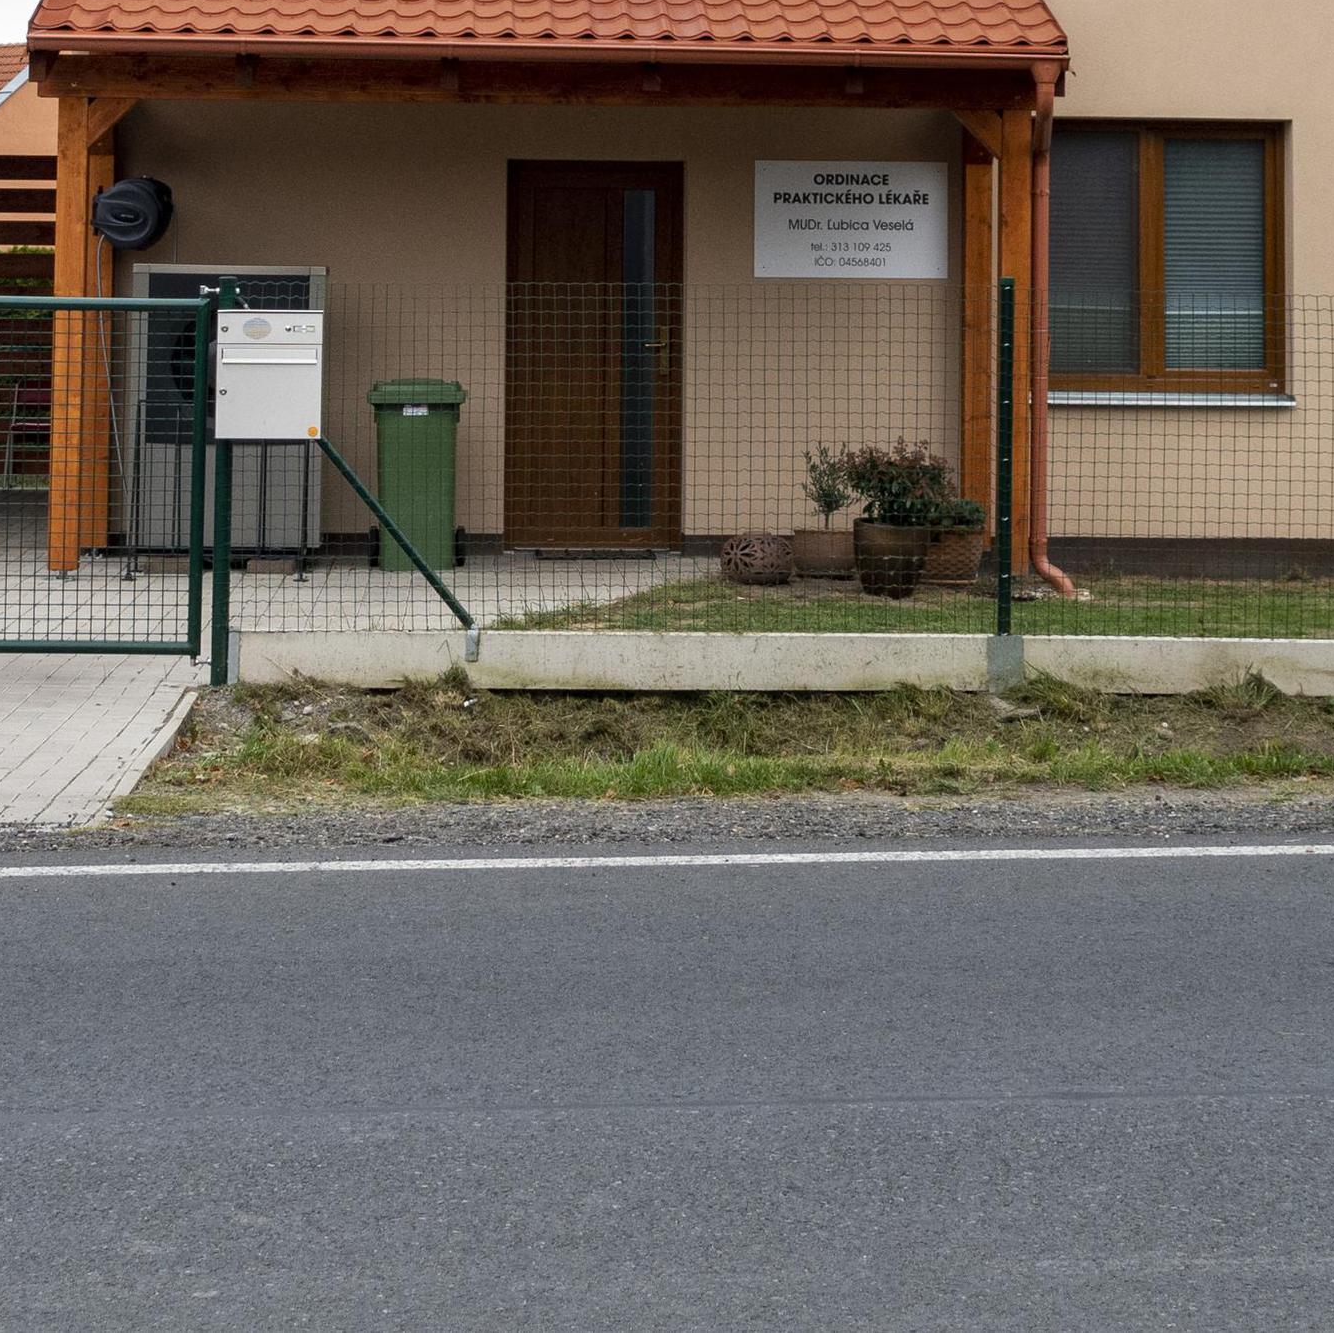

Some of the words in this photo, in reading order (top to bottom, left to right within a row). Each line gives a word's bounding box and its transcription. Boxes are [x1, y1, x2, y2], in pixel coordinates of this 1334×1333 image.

[813, 173, 890, 186] ORDINACE
[773, 189, 875, 205] PRAKTICKÉHO
[878, 190, 930, 205] LÉKAŘE
[788, 218, 823, 231] MUDr.
[827, 218, 869, 231] Ľubica
[872, 219, 914, 231] Veselá
[810, 242, 828, 252] tel.:
[830, 242, 849, 252] 313
[853, 242, 871, 252] 109
[873, 242, 892, 252] 425
[814, 255, 836, 267] IČO:
[838, 257, 886, 267] 04568401
